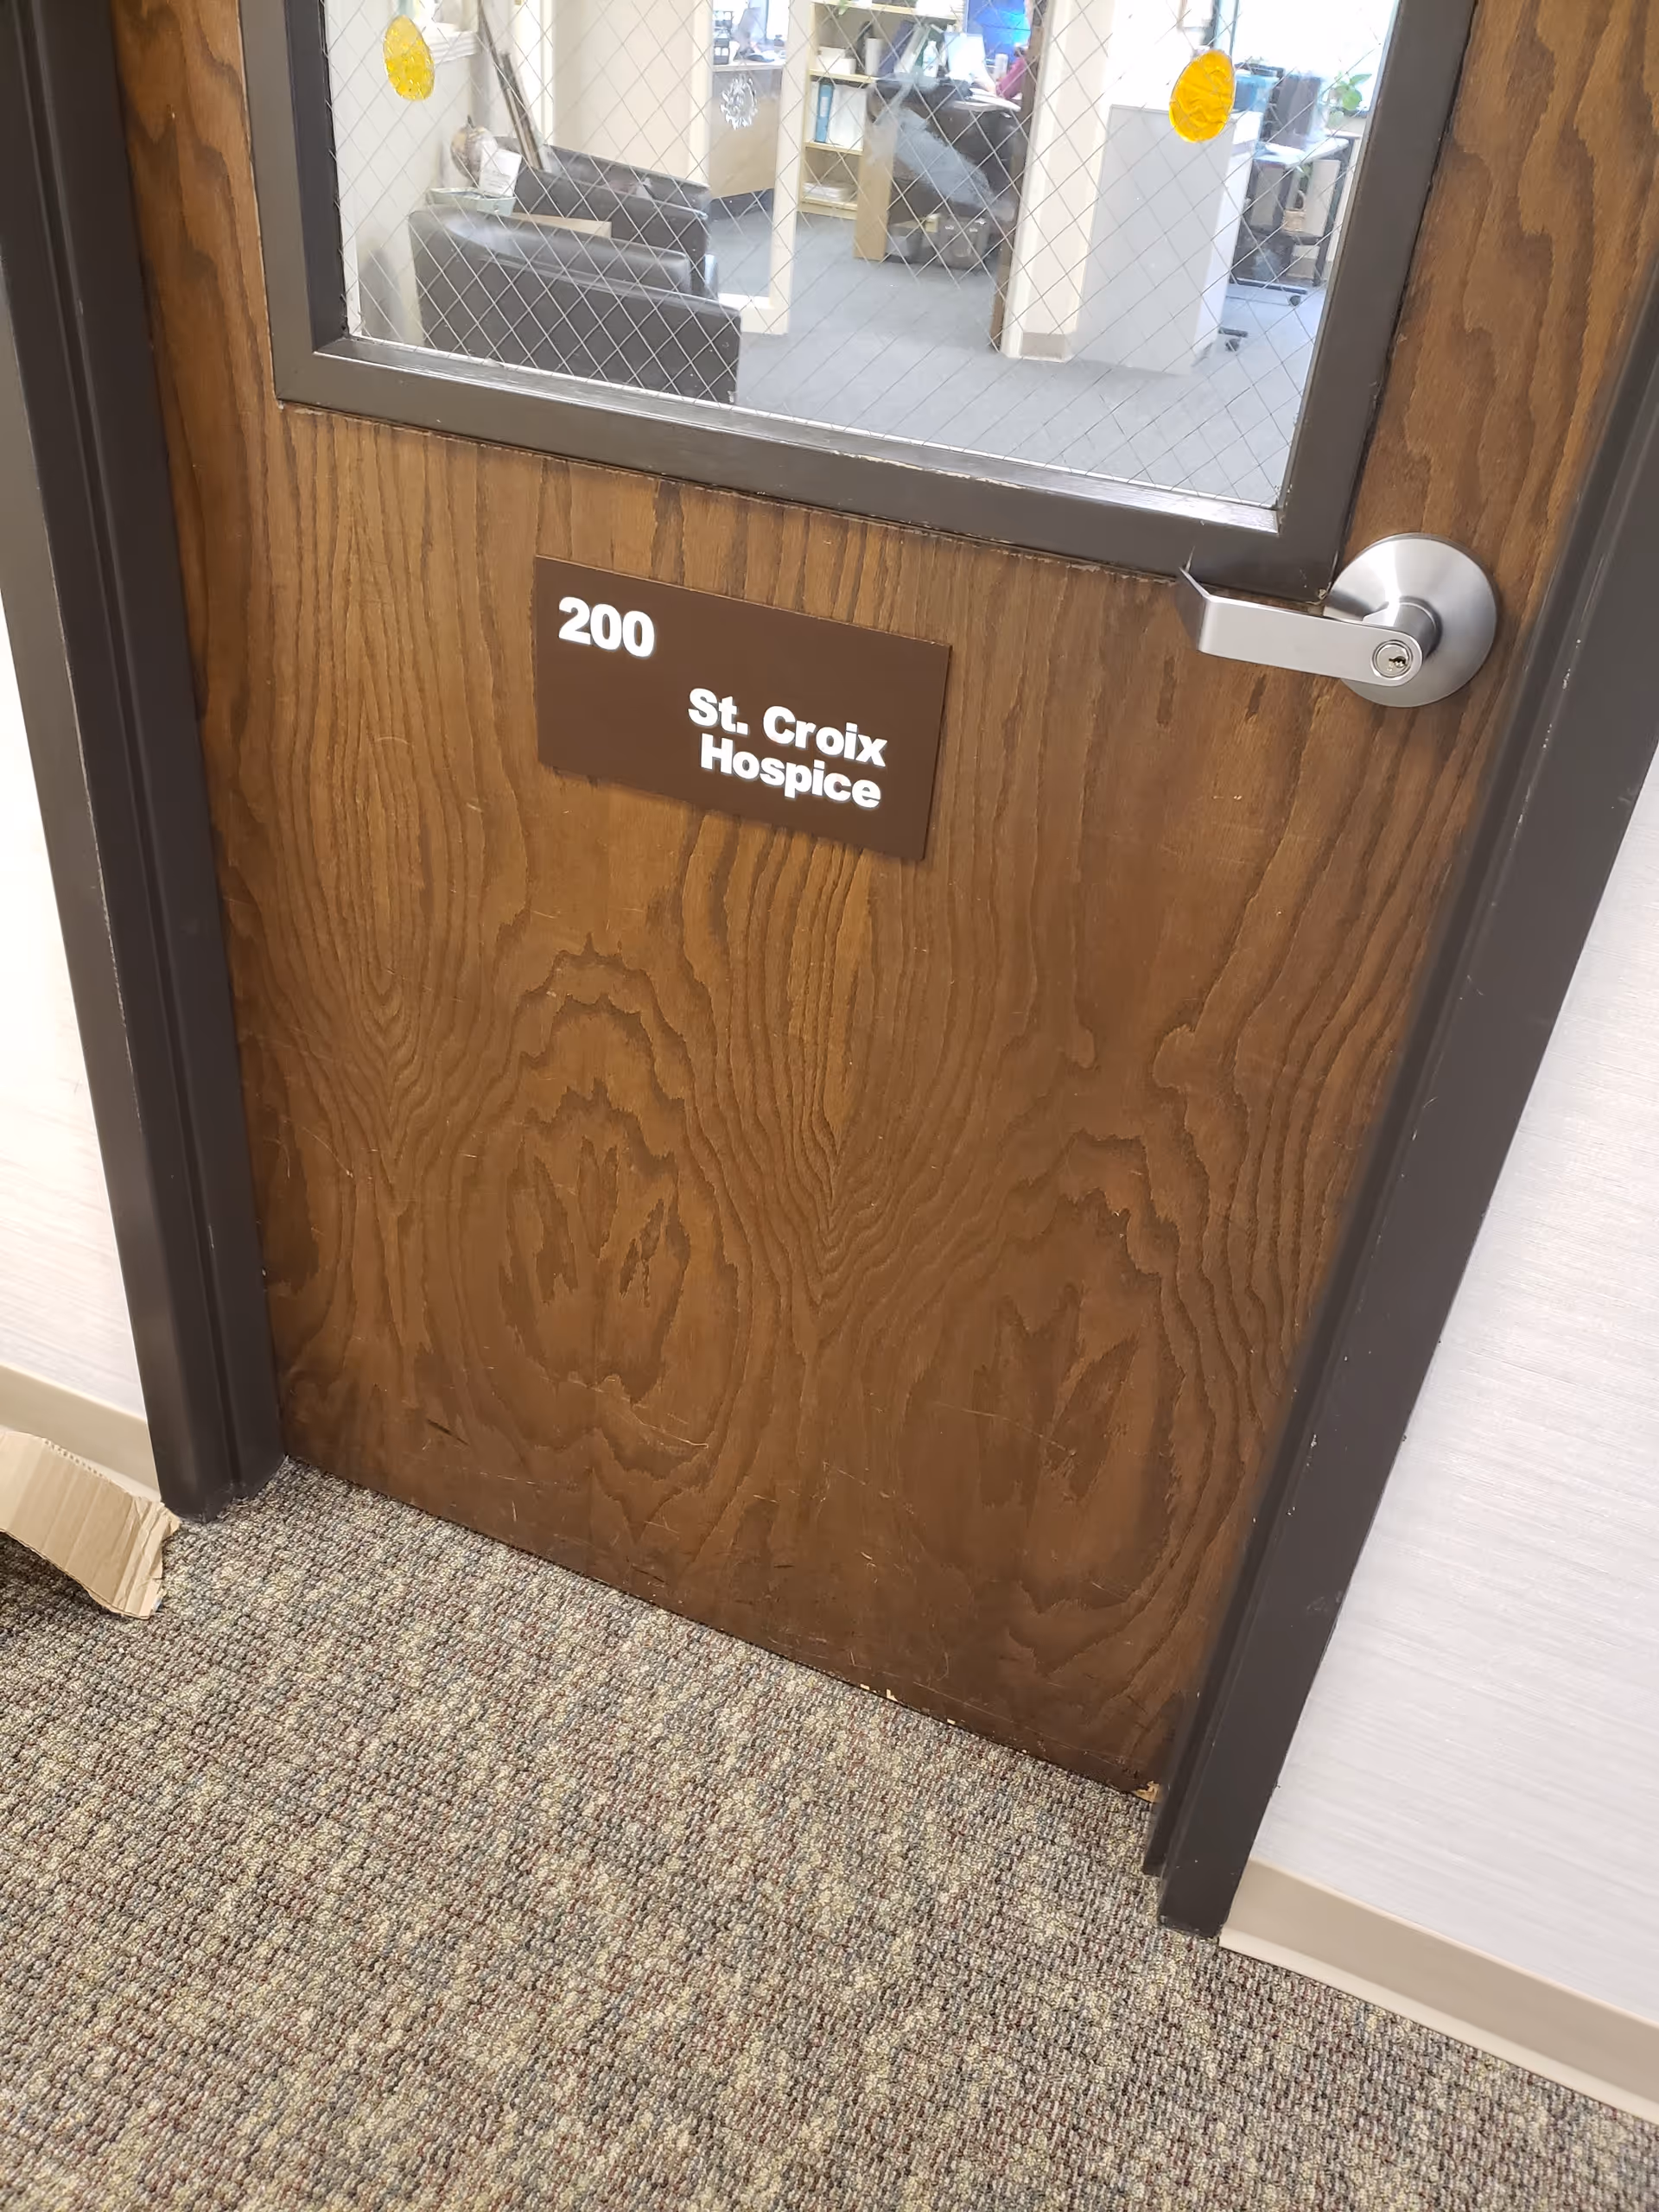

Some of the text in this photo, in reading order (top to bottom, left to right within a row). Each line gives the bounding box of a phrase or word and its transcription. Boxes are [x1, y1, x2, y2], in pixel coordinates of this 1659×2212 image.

[558, 596, 655, 658] 200
[688, 688, 888, 767] St. Croix
[701, 733, 881, 809] Hospice
